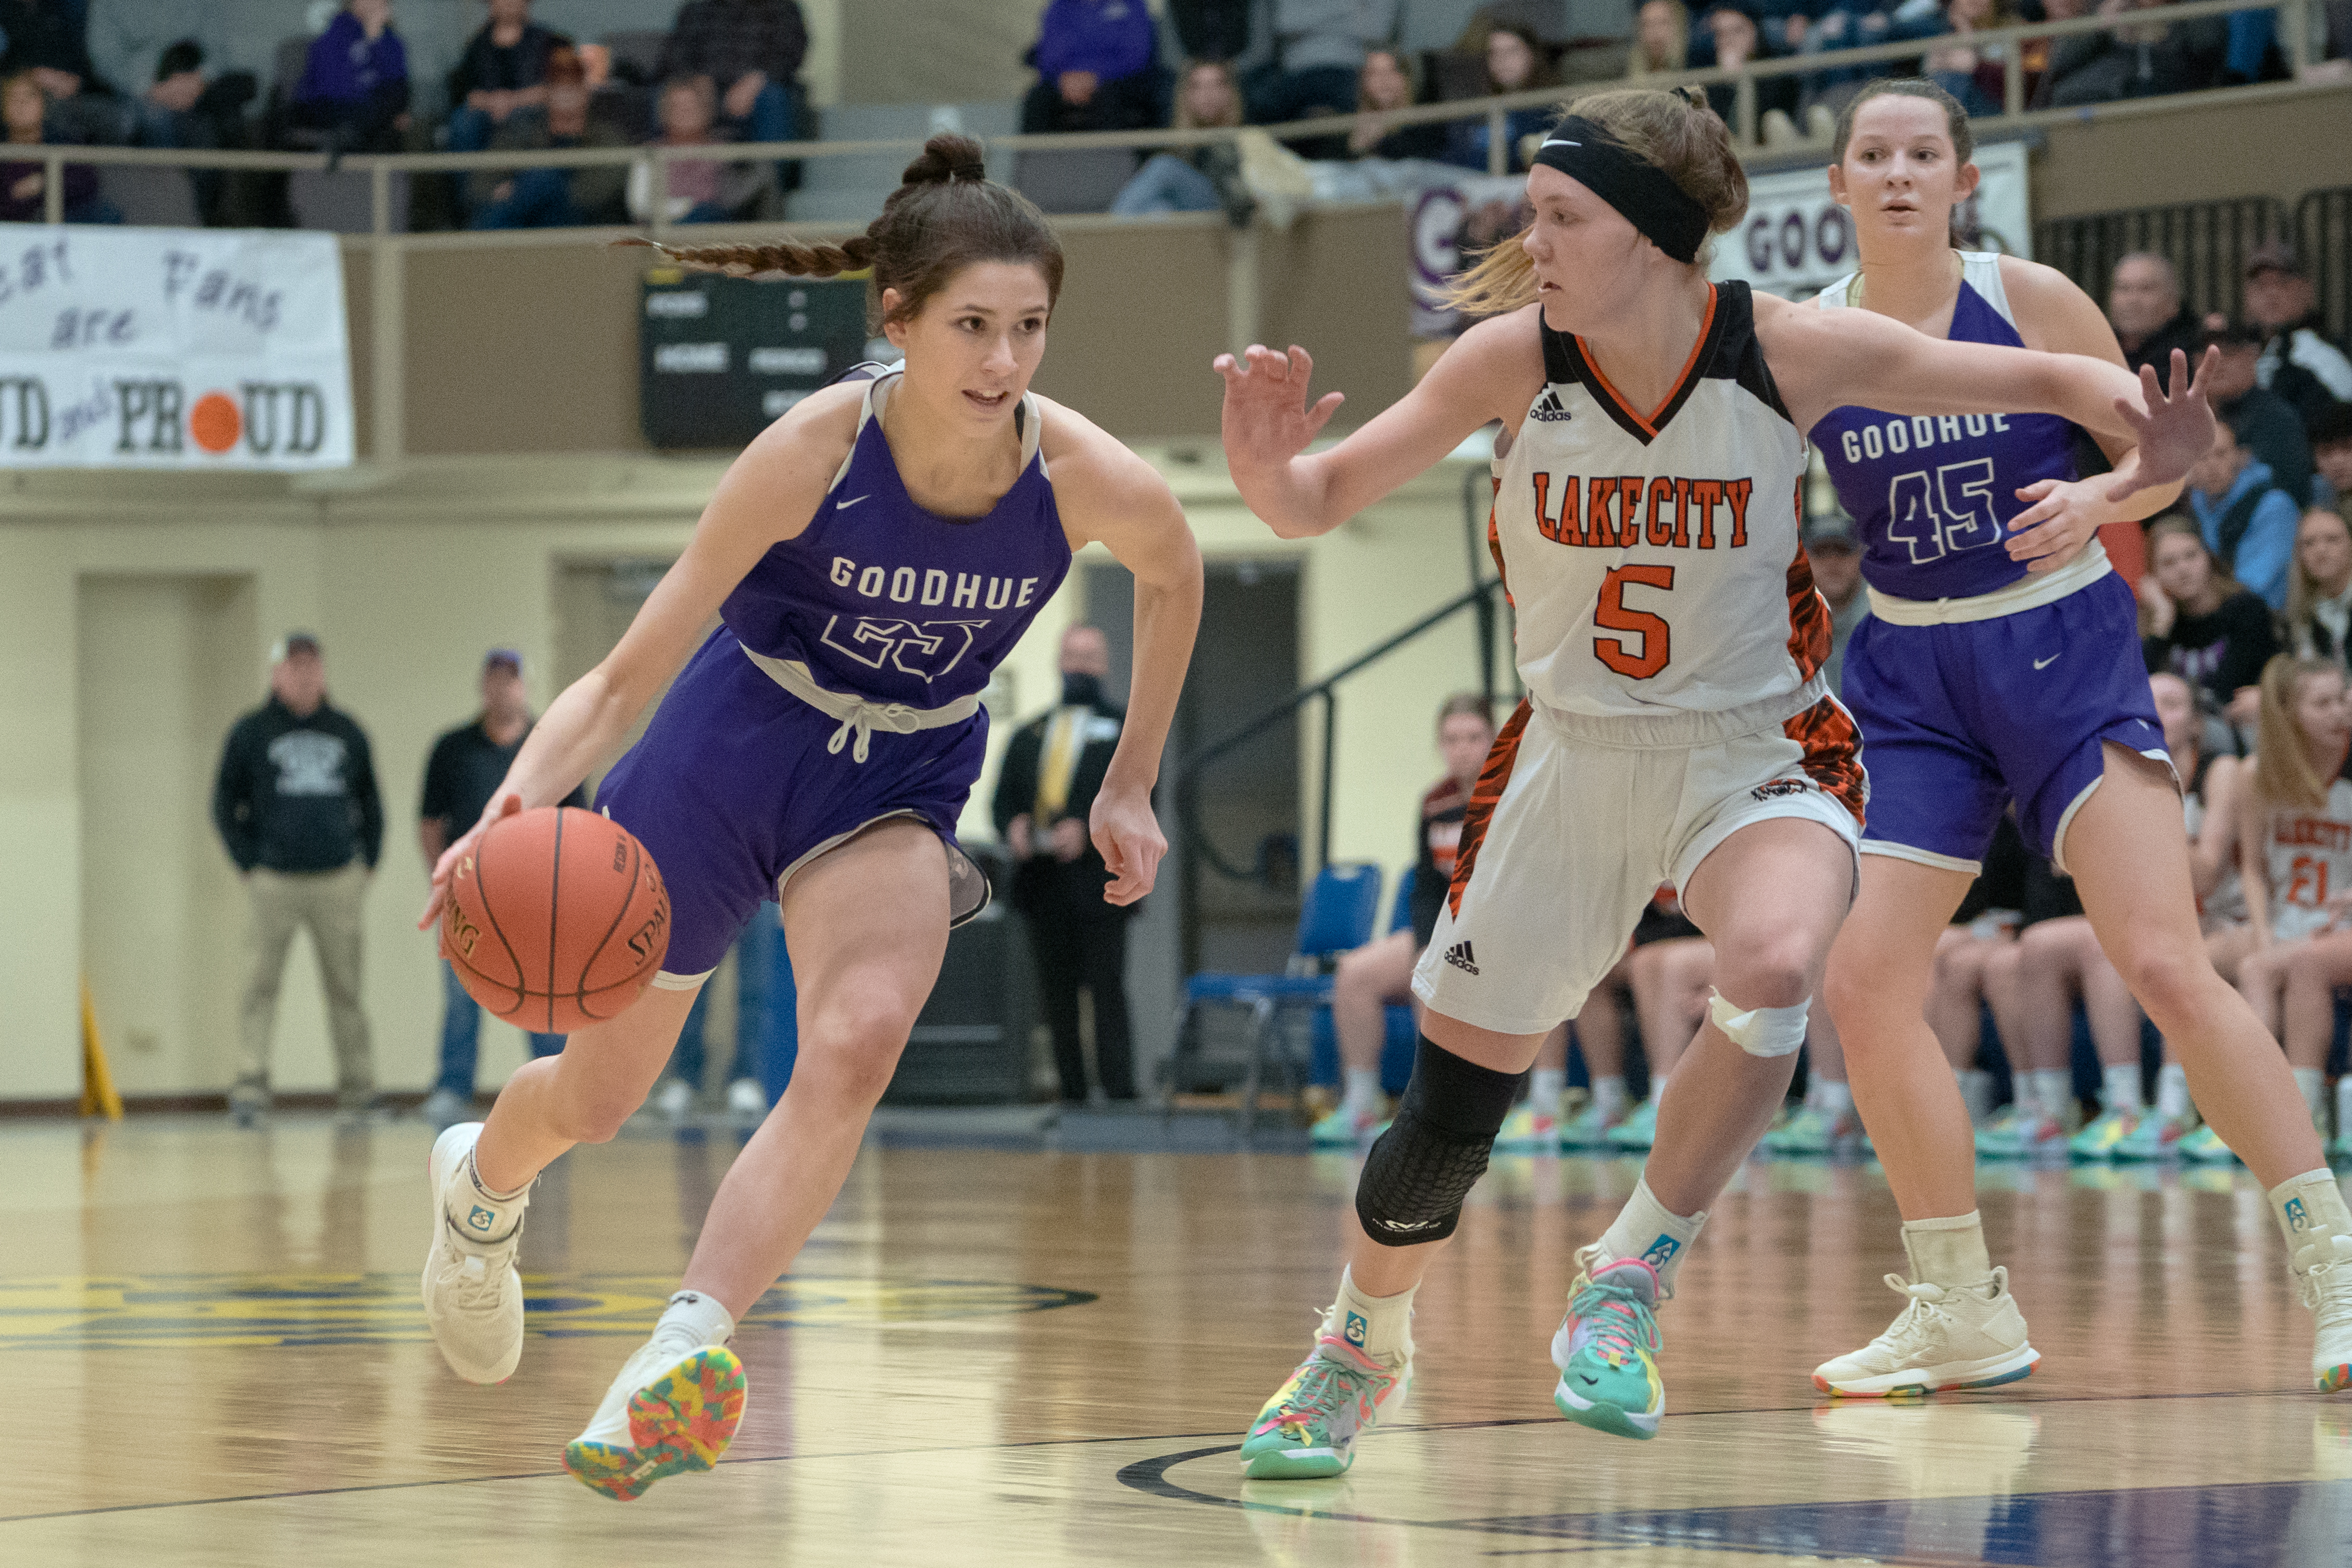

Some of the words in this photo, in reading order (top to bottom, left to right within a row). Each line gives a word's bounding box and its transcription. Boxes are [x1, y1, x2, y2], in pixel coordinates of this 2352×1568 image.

[54, 307, 134, 349] are
[1530, 408, 1572, 422] adidas
[1887, 457, 2001, 565] 45
[830, 556, 1039, 609] GOODHUE
[1593, 563, 1675, 680] 5
[2286, 856, 2328, 909] 21
[1444, 951, 1480, 975] adidas
